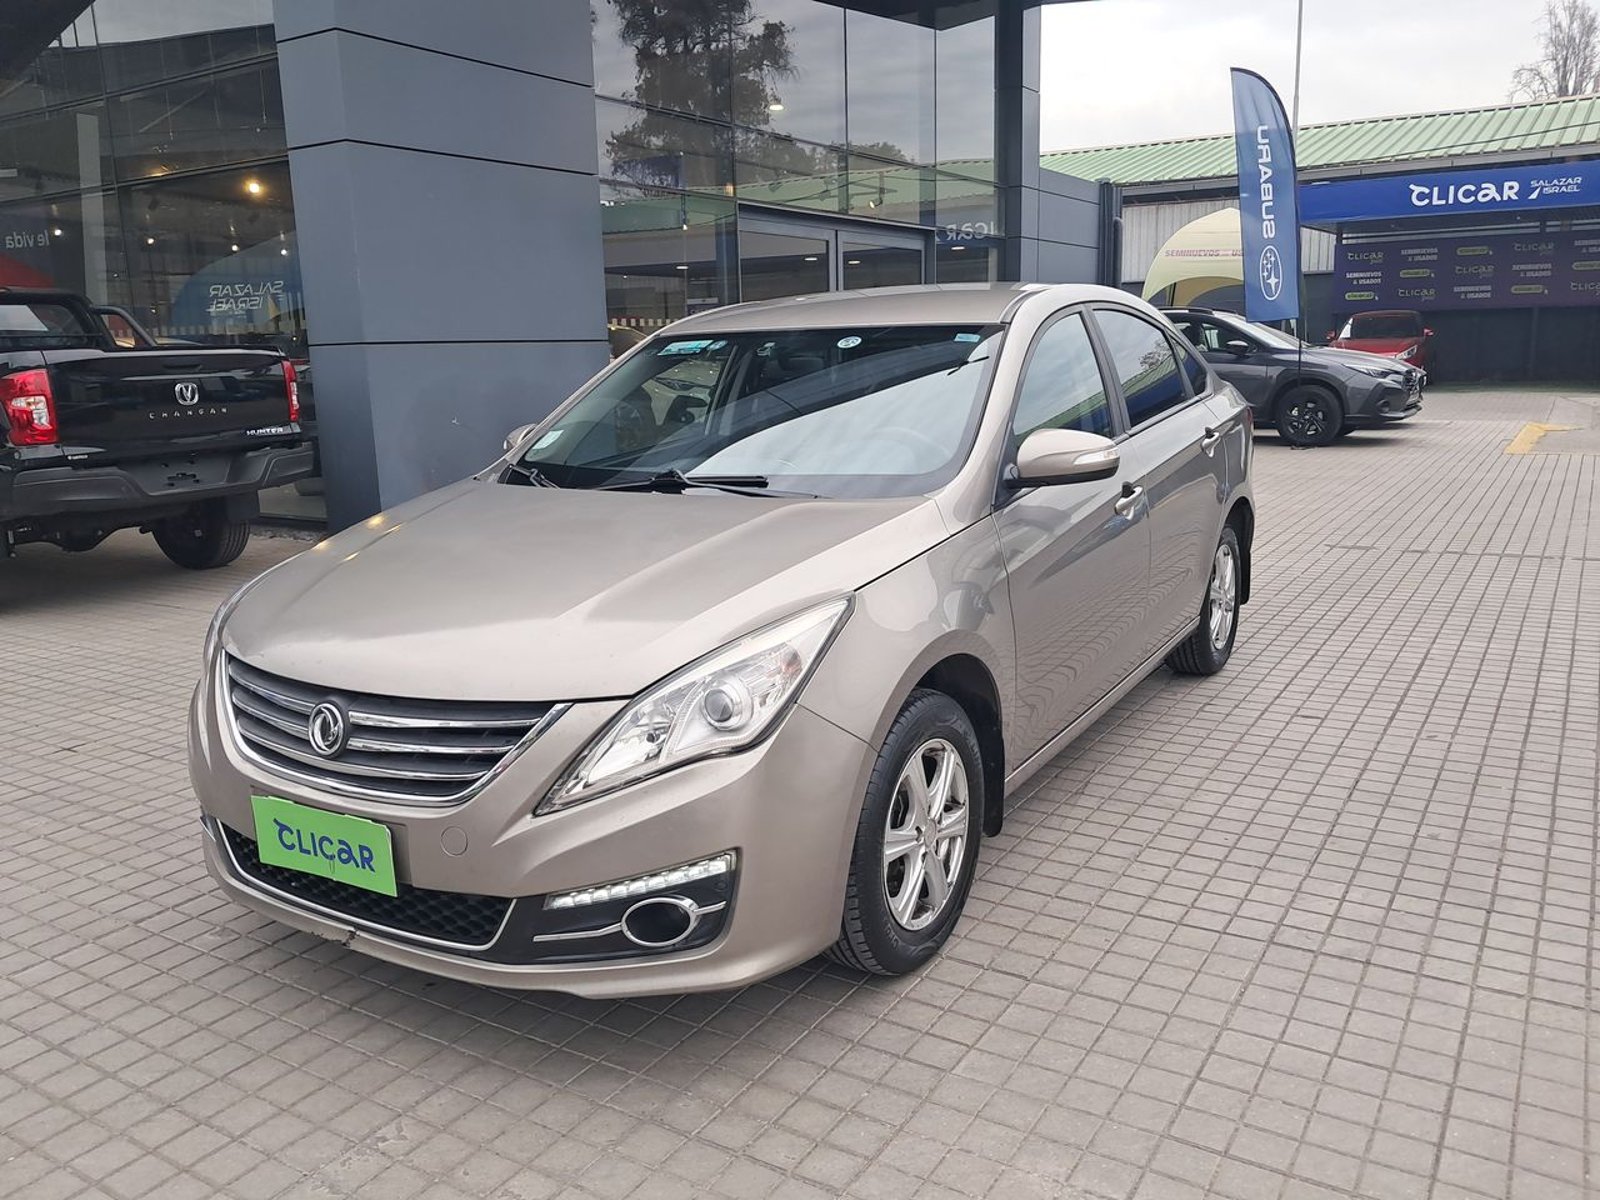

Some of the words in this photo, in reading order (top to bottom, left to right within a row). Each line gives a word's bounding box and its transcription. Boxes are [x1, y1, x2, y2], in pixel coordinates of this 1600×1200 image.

[1530, 177, 1582, 188] SALAZAR
[1542, 185, 1581, 194] ISRAEL
[149, 408, 228, 420] CHANGAN
[246, 427, 283, 435] HUNTER
